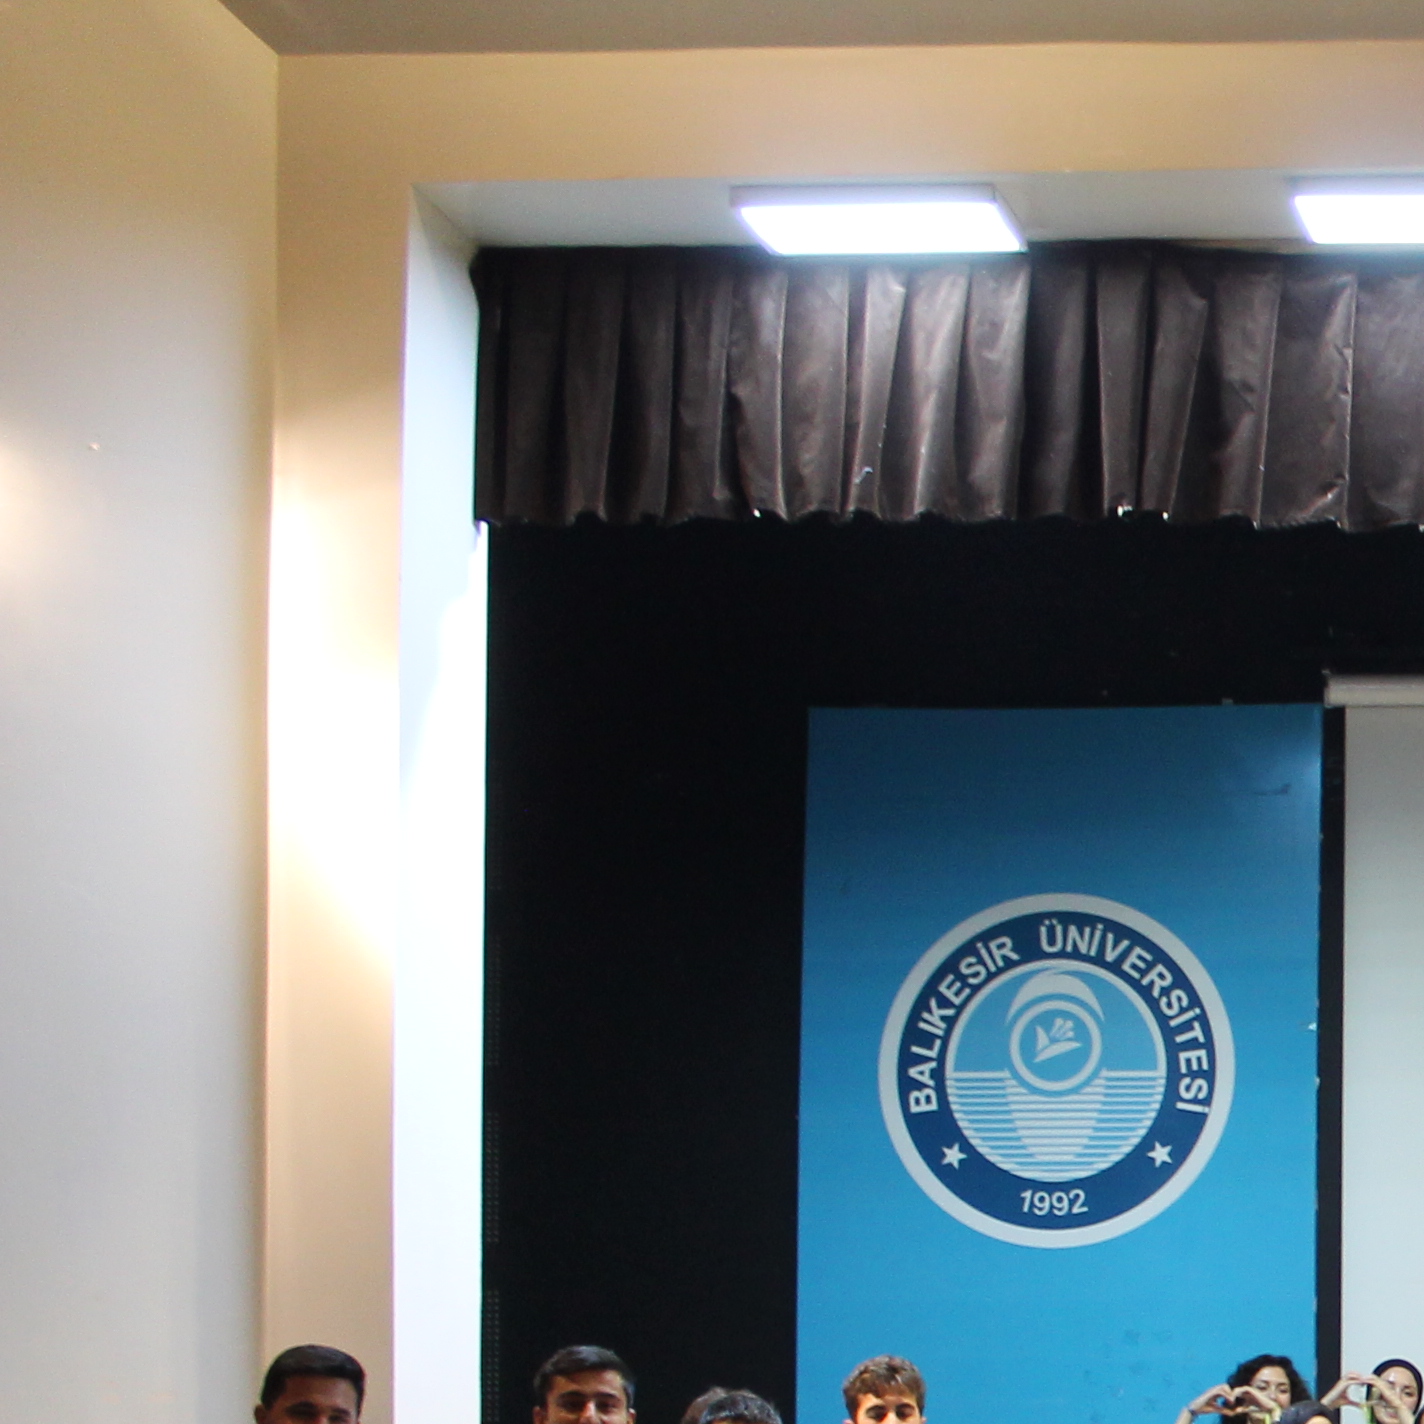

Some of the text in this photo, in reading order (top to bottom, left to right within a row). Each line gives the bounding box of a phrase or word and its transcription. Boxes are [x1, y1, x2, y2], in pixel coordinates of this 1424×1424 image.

[907, 919, 1210, 1115] BALIKESİR ÜNİVERSİTESİ
[1020, 1188, 1089, 1216] 1992
